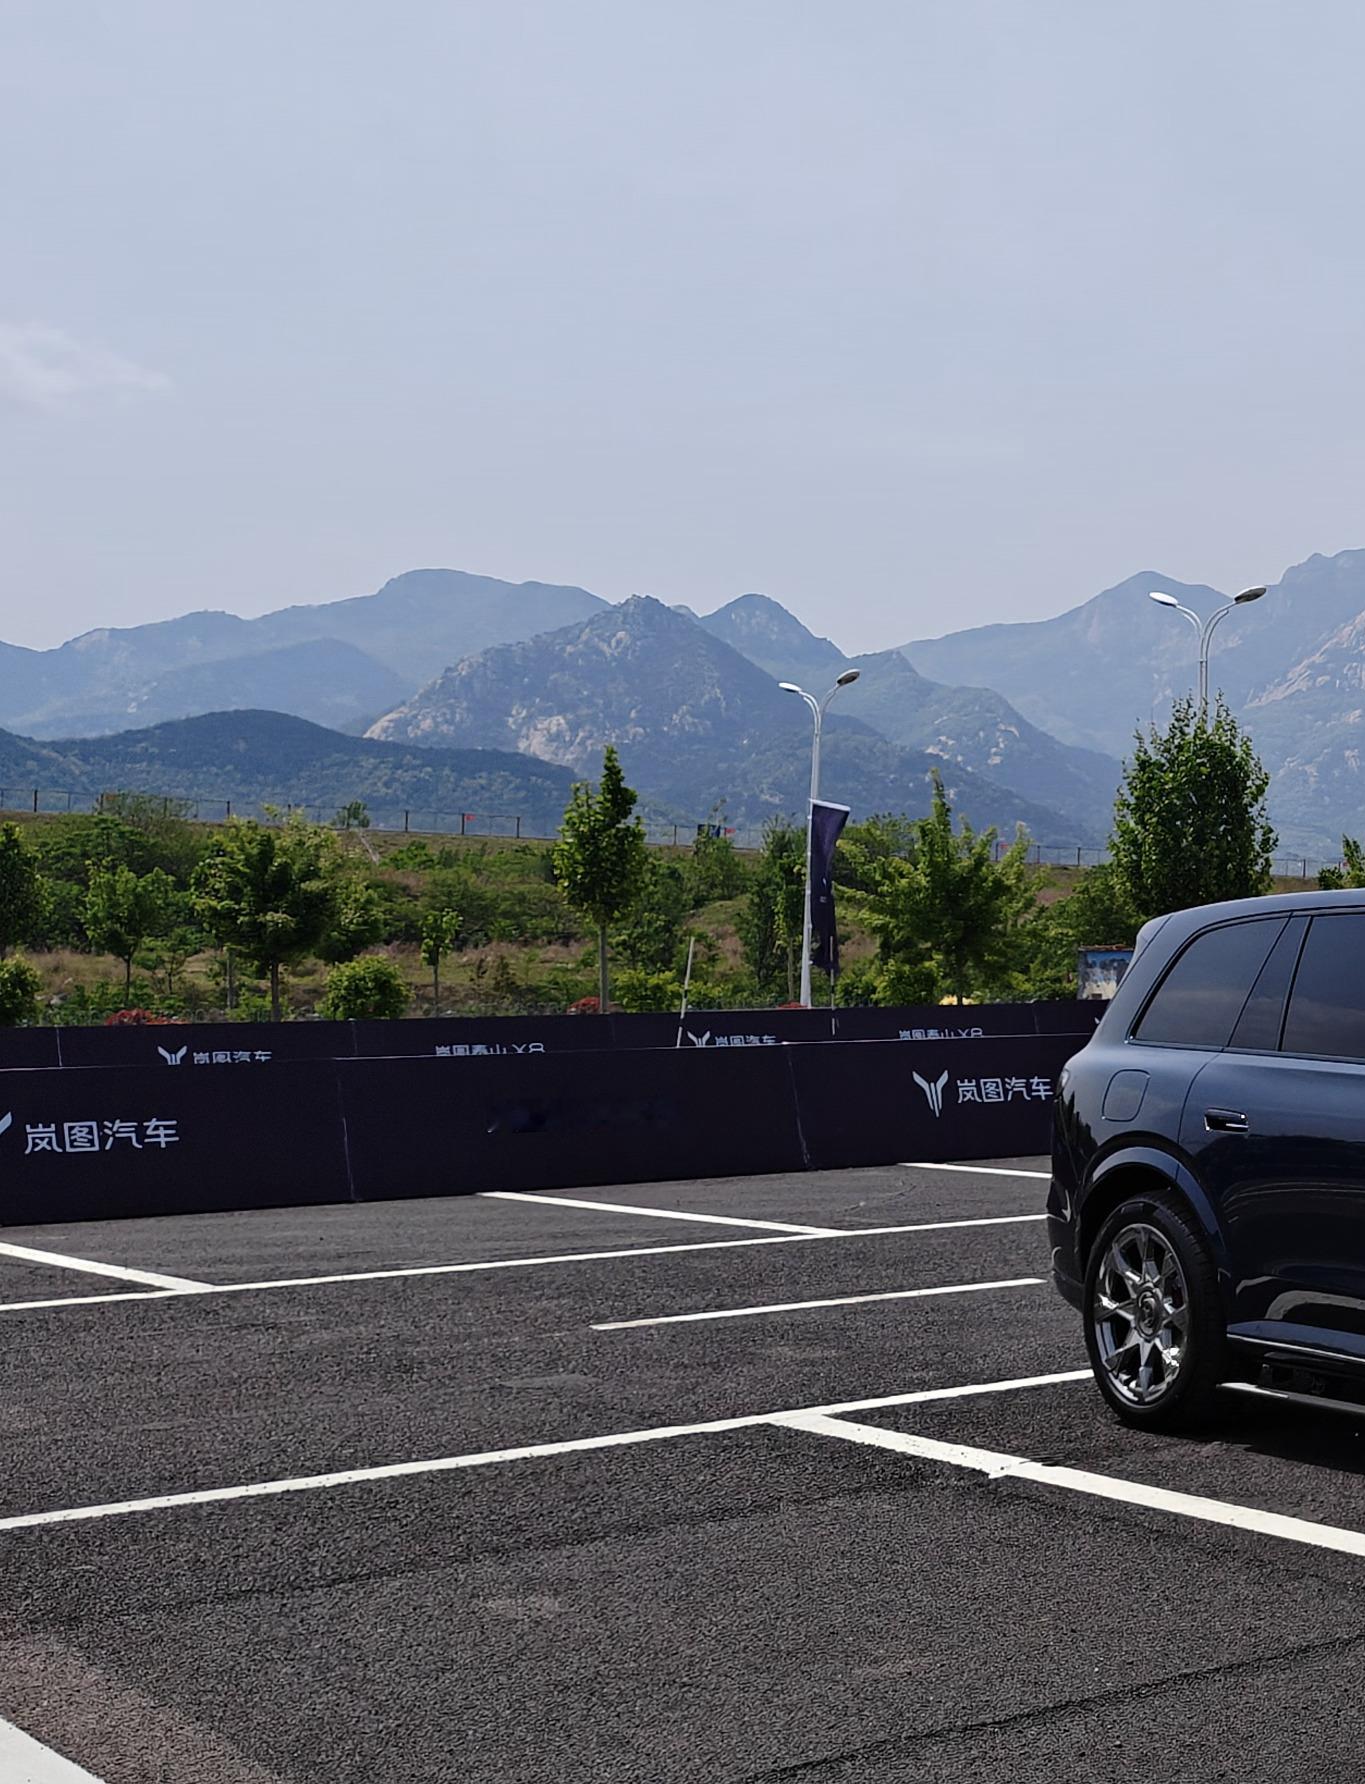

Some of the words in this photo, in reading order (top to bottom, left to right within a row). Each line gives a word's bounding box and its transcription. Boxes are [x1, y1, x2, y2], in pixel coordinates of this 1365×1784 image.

[956, 1076, 1054, 1104] 岚图汽车
[24, 1117, 180, 1155] 岚图汽车
